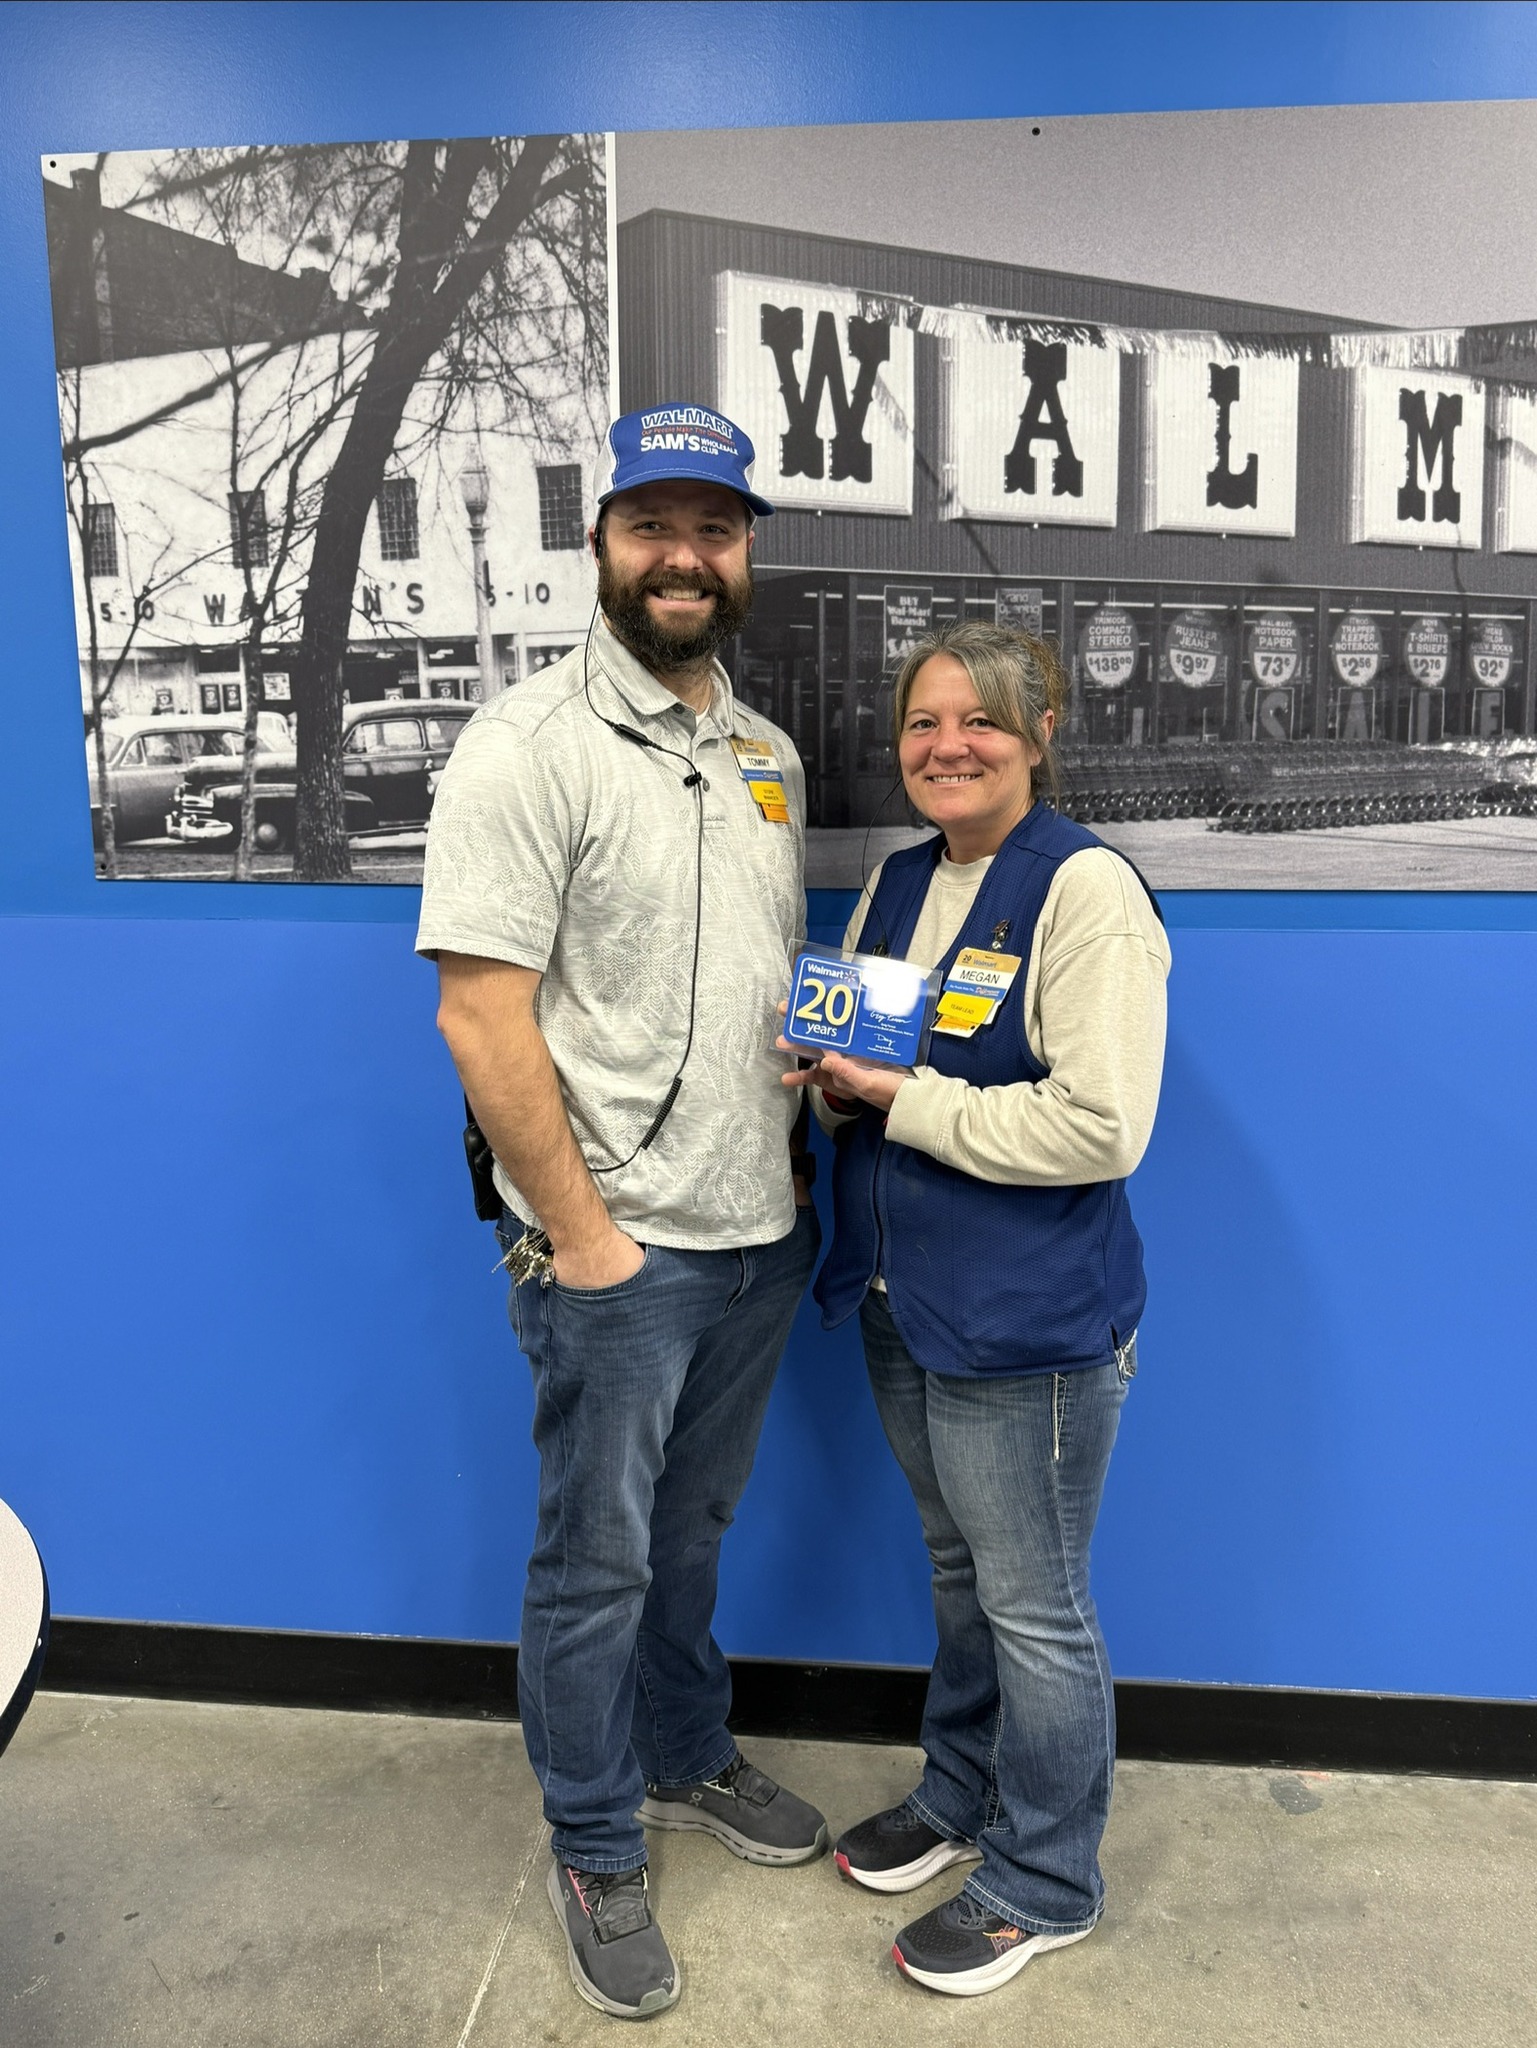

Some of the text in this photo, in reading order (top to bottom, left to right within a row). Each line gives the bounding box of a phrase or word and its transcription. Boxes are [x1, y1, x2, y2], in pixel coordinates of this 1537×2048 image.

[653, 426, 675, 434] People
[640, 432, 700, 452] SAM'S
[700, 438, 739, 456] WHOLESALE
[700, 446, 719, 455] CLUB
[890, 616, 927, 627] Brands
[1088, 625, 1133, 636] COMPACT
[1175, 625, 1218, 642] RUSTLER
[1254, 627, 1297, 637] NOTEBOOK
[1340, 625, 1376, 634] TRAPPER
[1088, 635, 1132, 647] STEREO
[1179, 636, 1210, 649] JEANS
[1258, 636, 1293, 648] PAPER
[1340, 634, 1375, 643] KEEPER
[1409, 632, 1449, 644] T-SHIRTS
[1334, 642, 1380, 651] NOTEBOOK
[1407, 643, 1449, 655] & BRIEFS
[973, 958, 998, 969] Walmart
[807, 962, 844, 979] Walmart
[959, 969, 1001, 984] MEGAN
[796, 978, 854, 1026] 20
[805, 1022, 838, 1037] years
